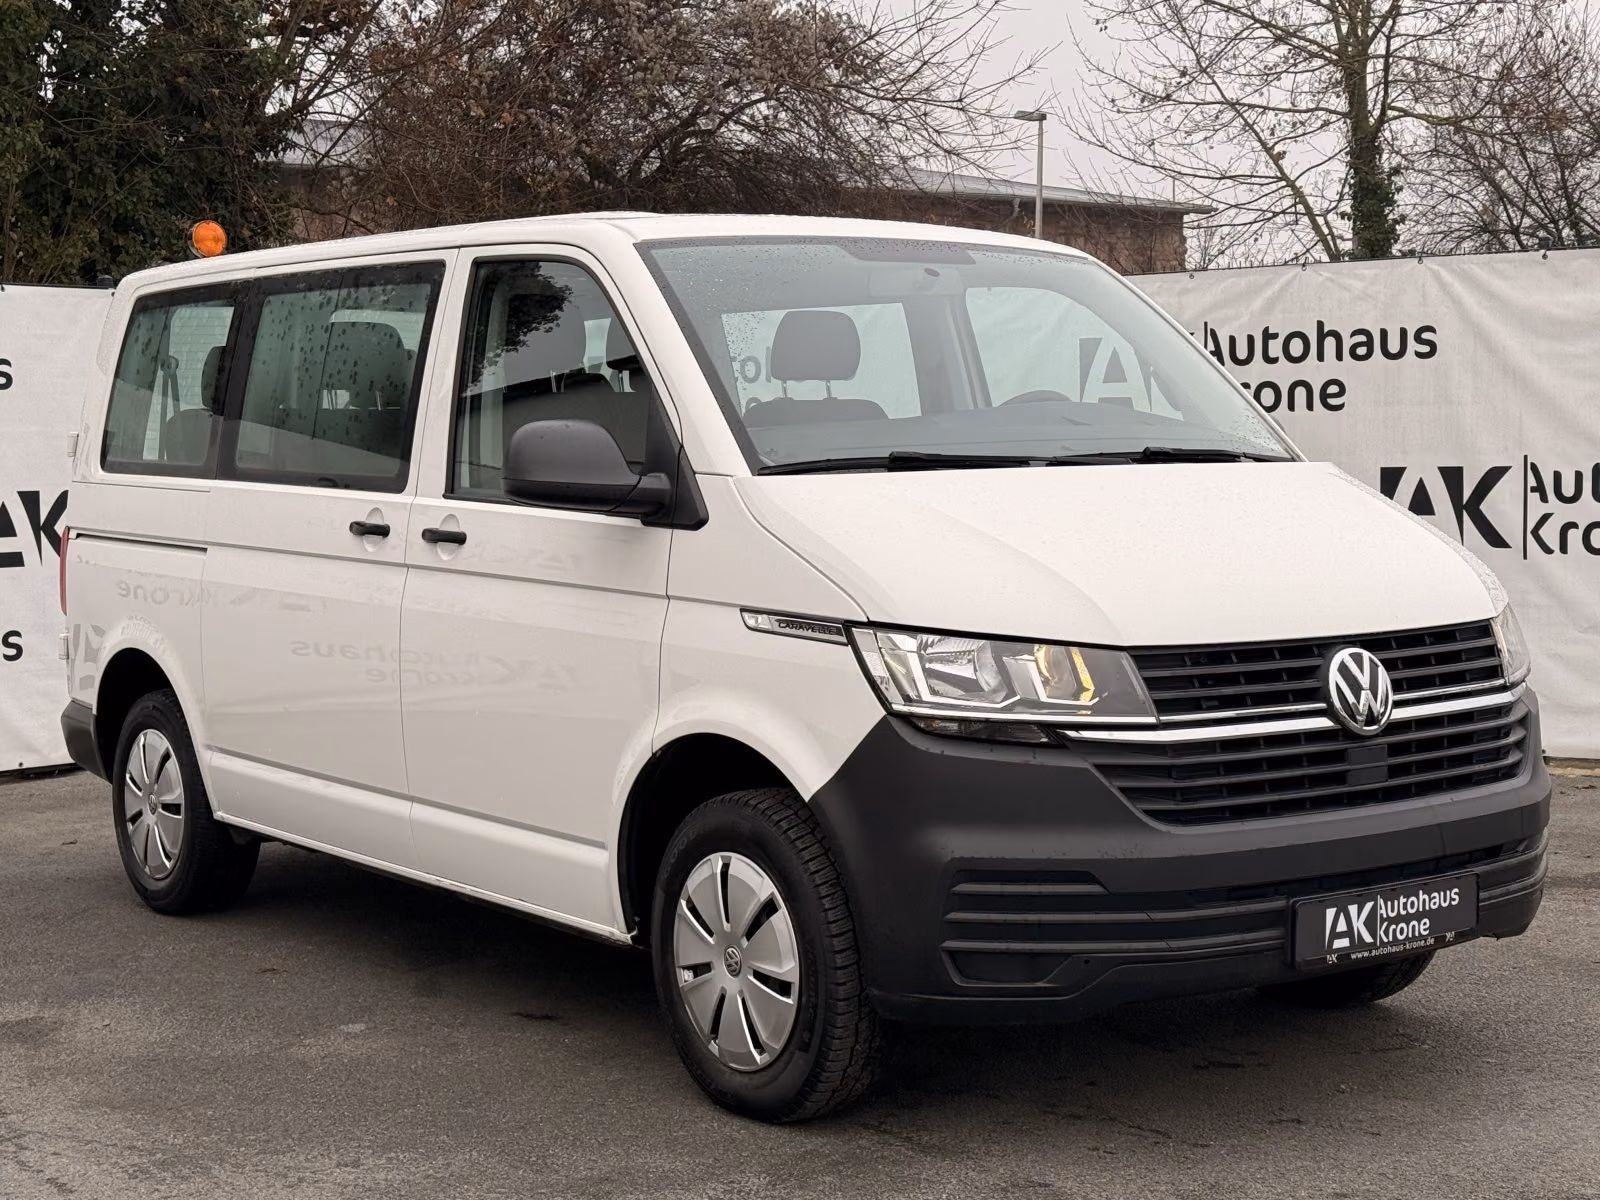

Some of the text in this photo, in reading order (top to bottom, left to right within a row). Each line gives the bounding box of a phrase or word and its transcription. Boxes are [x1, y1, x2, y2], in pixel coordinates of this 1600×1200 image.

[1209, 319, 1438, 367] Autohaus
[1380, 466, 1513, 549] AK
[1325, 888, 1460, 950] AK Autohaus
[1379, 917, 1430, 943] Krone
[1350, 936, 1435, 960] www.autohaus-krone.de
